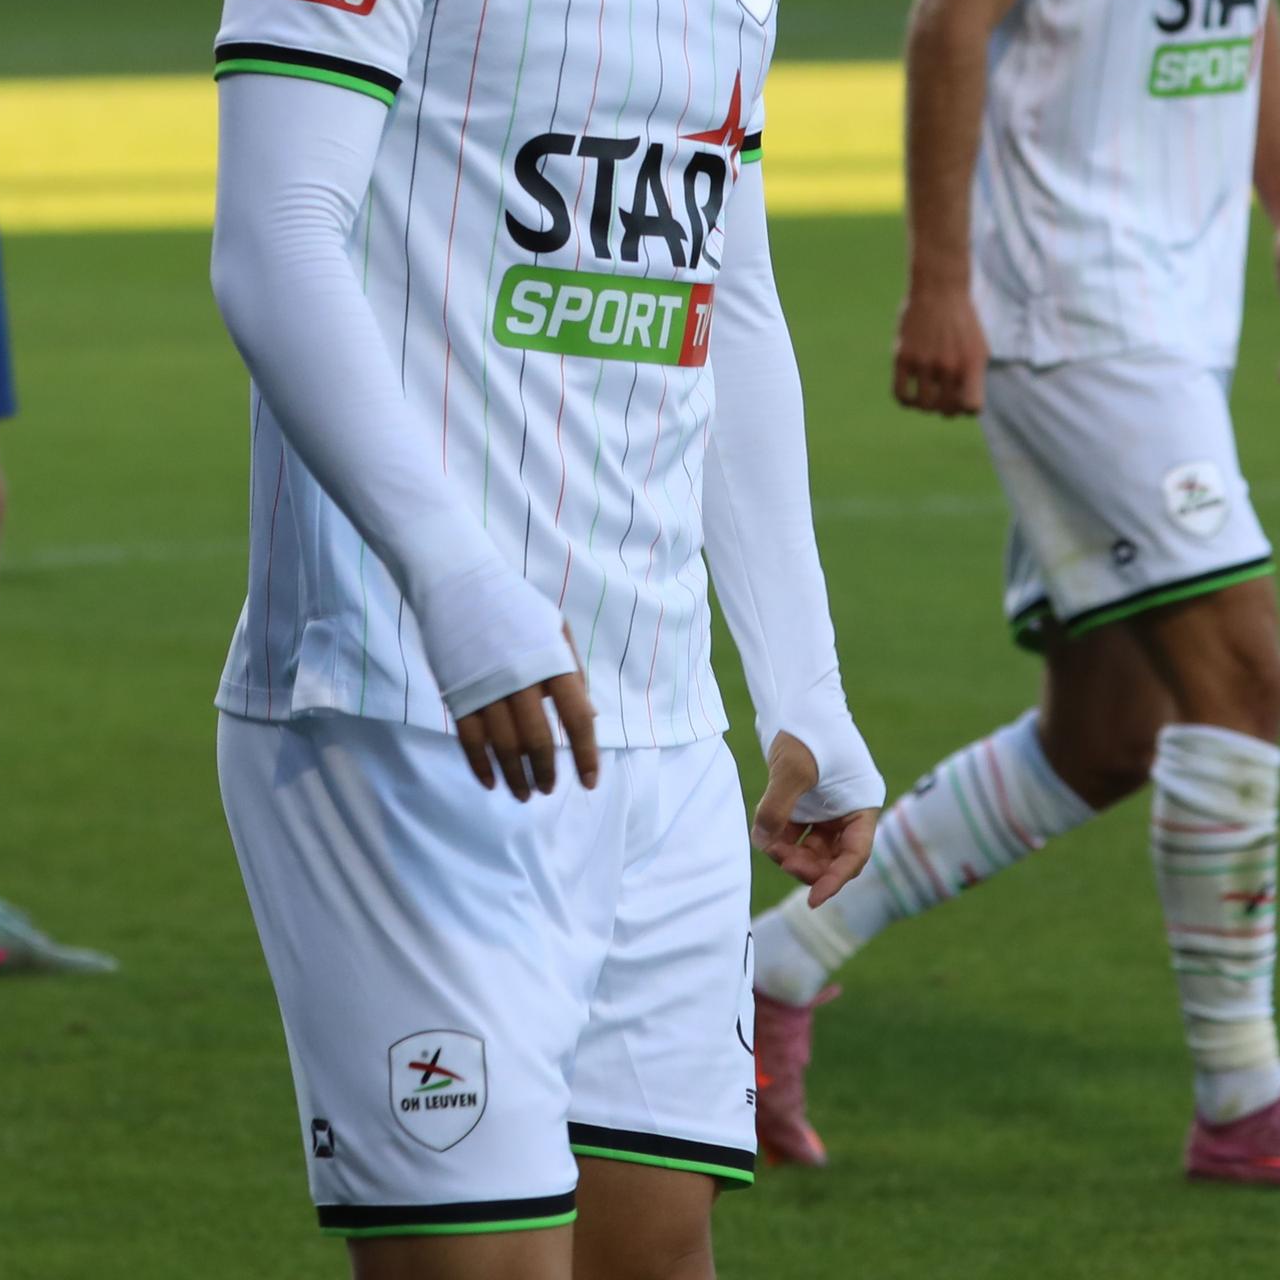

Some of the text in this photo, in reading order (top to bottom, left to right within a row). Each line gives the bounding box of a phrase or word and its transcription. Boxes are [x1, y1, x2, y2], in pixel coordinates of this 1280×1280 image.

[505, 132, 726, 271] STAR
[506, 278, 683, 350] SPORT
[401, 1093, 477, 1112] OH LEUVEN
